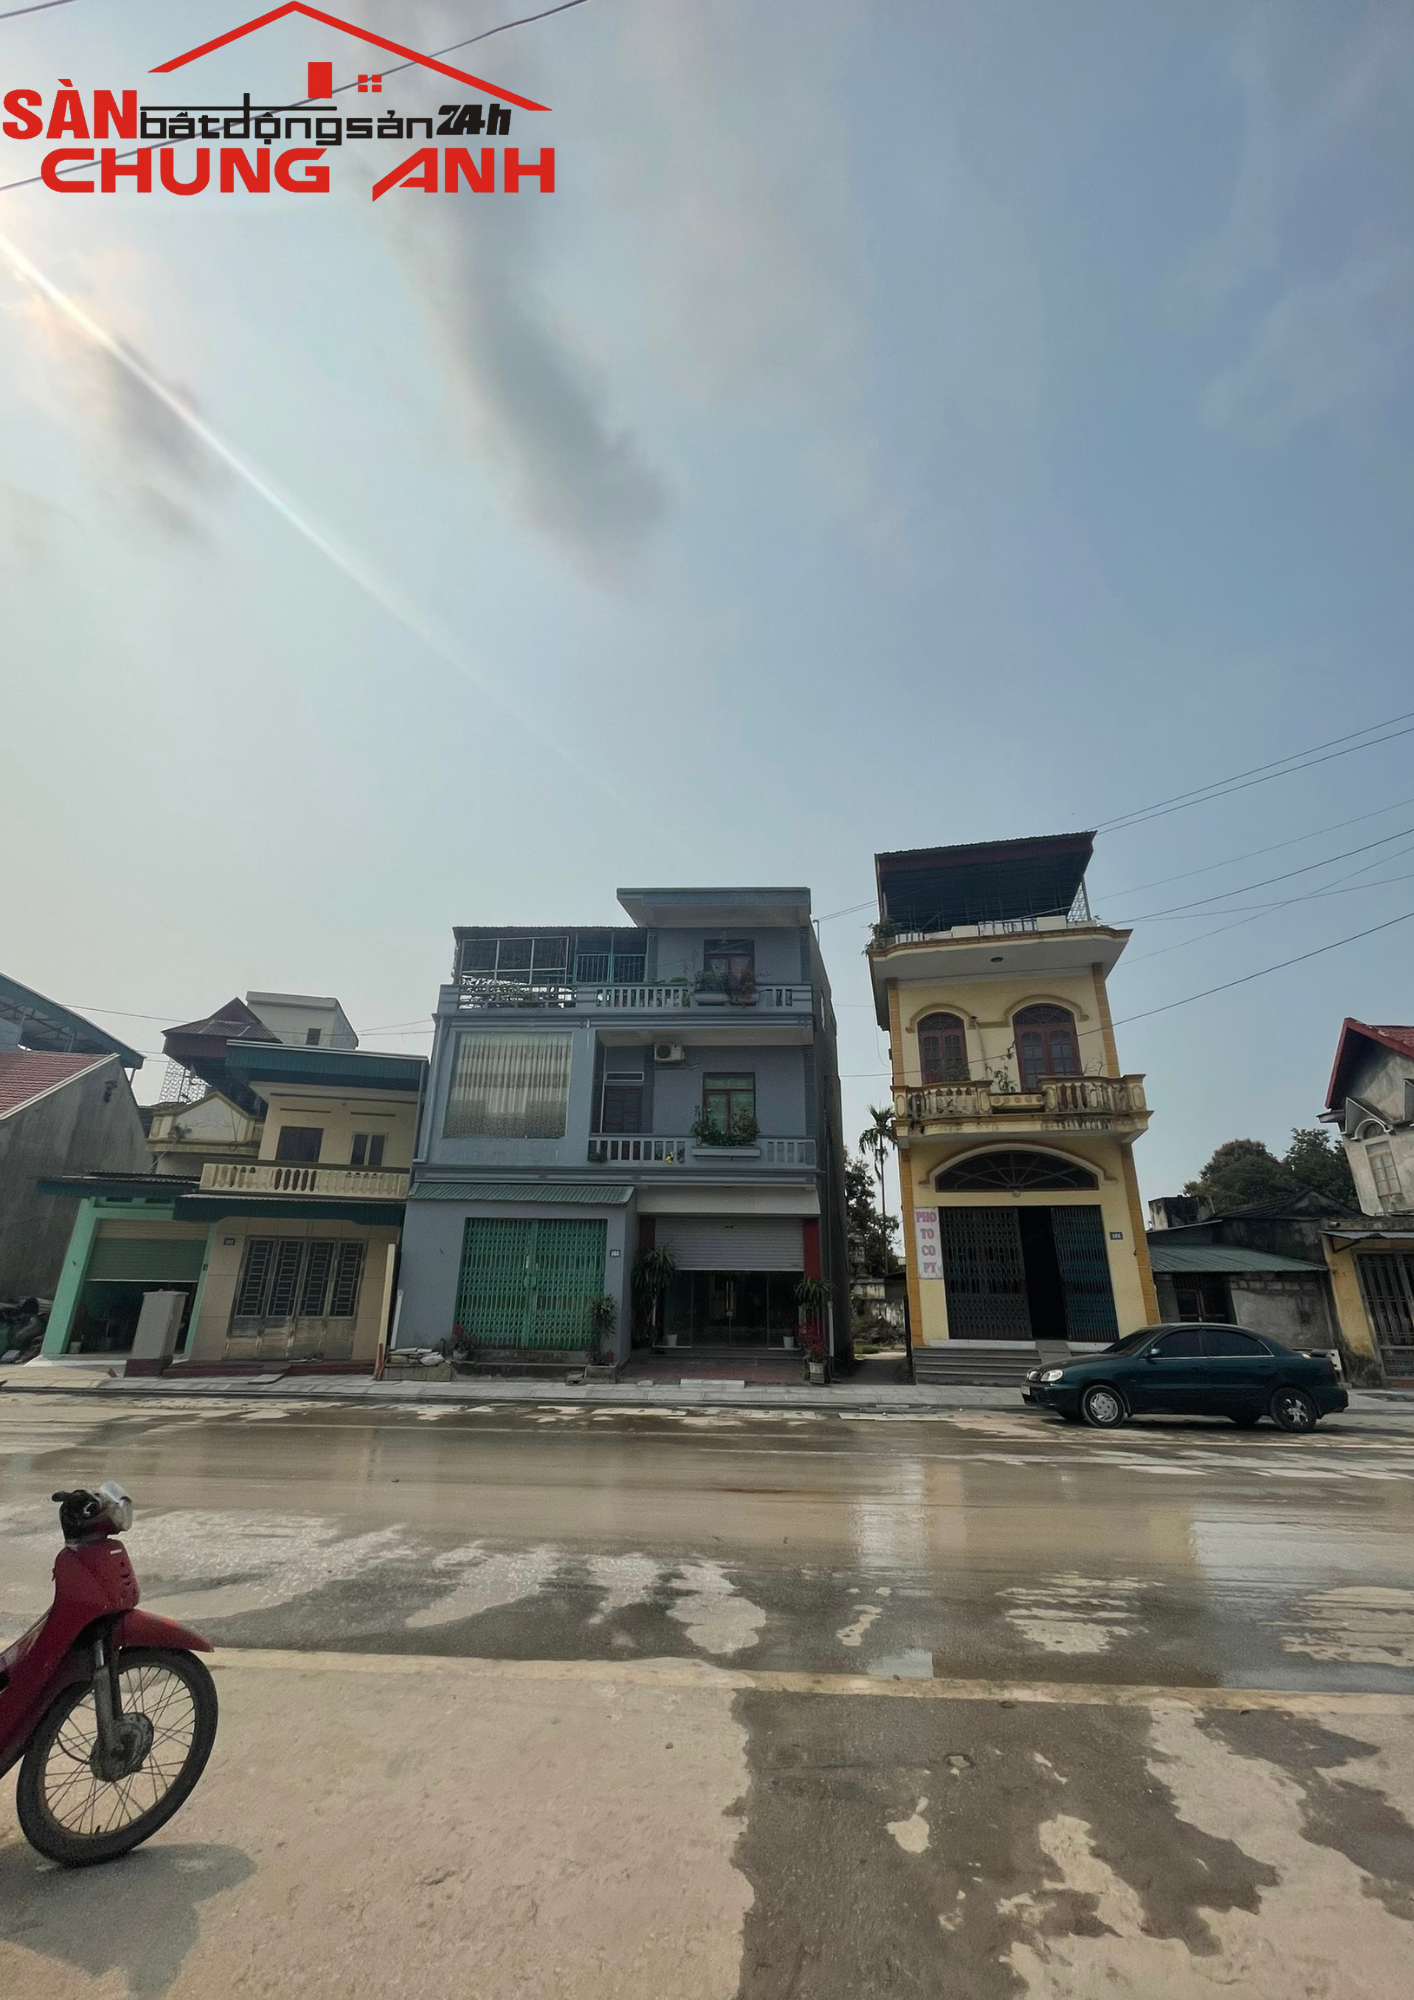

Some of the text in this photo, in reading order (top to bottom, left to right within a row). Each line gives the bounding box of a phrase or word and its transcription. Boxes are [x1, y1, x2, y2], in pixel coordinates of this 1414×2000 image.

[916, 1211, 937, 1223] PHO
[920, 1228, 934, 1239] TO
[921, 1245, 936, 1256] CO
[923, 1262, 937, 1273] PY
